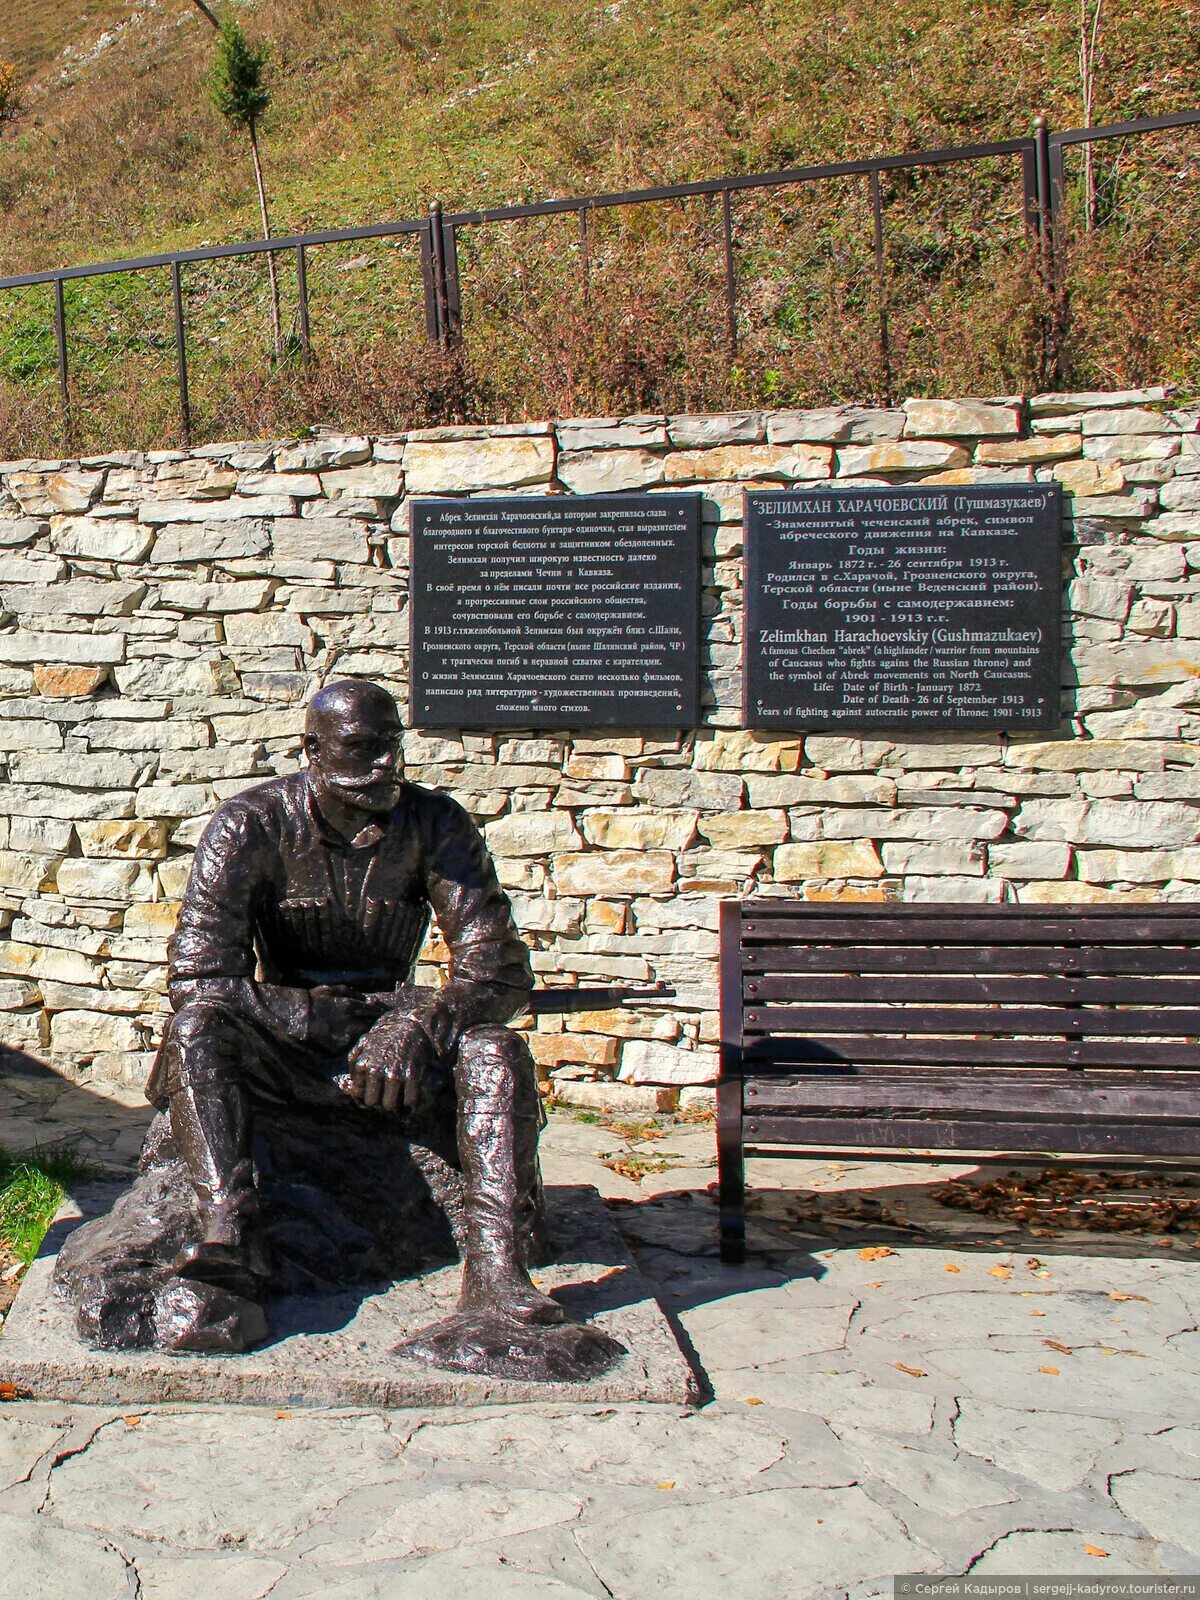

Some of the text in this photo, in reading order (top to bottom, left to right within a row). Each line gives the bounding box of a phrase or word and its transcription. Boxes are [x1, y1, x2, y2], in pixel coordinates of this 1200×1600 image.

[758, 500, 831, 514] ЗЕЛИМХАН
[837, 495, 948, 512] ХАРАЧОЕВСКИЙ
[464, 512, 498, 521] Зелимхан
[861, 516, 930, 526] чеченский
[936, 516, 979, 527] абрек,
[985, 516, 1034, 524] символ
[779, 531, 858, 542] абреческого
[864, 530, 932, 539] движения
[961, 527, 1018, 536] Кавказе.
[848, 545, 946, 556] Годы жизни:
[447, 555, 487, 564] Зелимхан
[789, 561, 832, 571] Январь
[839, 559, 865, 568] 1872
[887, 559, 901, 568] 26
[907, 558, 962, 569] сентября
[969, 557, 997, 566] 1913
[767, 572, 815, 582] Родился
[903, 571, 986, 582] Грозненского
[992, 571, 1037, 581] округа,
[762, 582, 1043, 595] Терской области (ныне Веденский район).
[782, 598, 1014, 611] Годы борьбы с самодержавием:
[846, 613, 875, 622] 1901
[891, 613, 923, 622] 1913
[524, 625, 563, 634] Зелимхан
[760, 628, 1042, 645] Zelimkhan Harachoevskiy (Gushmazukaev)
[761, 645, 766, 654] A
[768, 645, 797, 654] famous
[801, 645, 835, 654] Chechen
[935, 645, 966, 654] warrior
[970, 645, 990, 654] from
[995, 645, 1039, 654] mountains
[769, 658, 779, 667] of
[782, 658, 823, 667] Caucasus
[827, 658, 846, 667] who
[851, 658, 875, 669] fights
[913, 657, 928, 667] the
[933, 658, 969, 667] Russian
[973, 658, 1008, 668] throne)
[1013, 657, 1031, 667] and
[769, 671, 785, 680] the
[789, 671, 822, 682] symbol
[826, 670, 837, 679] of
[840, 670, 869, 679] Abrek
[874, 671, 928, 679] movements
[950, 669, 979, 679] North
[983, 669, 1031, 678] Caucasus.
[813, 681, 981, 693] Life: Date of Birth January 1872
[843, 693, 1023, 706] Date of Death 26 of September 1913
[757, 706, 1041, 718] Years of fighting against autocratic power of Throne: 1901 1913
